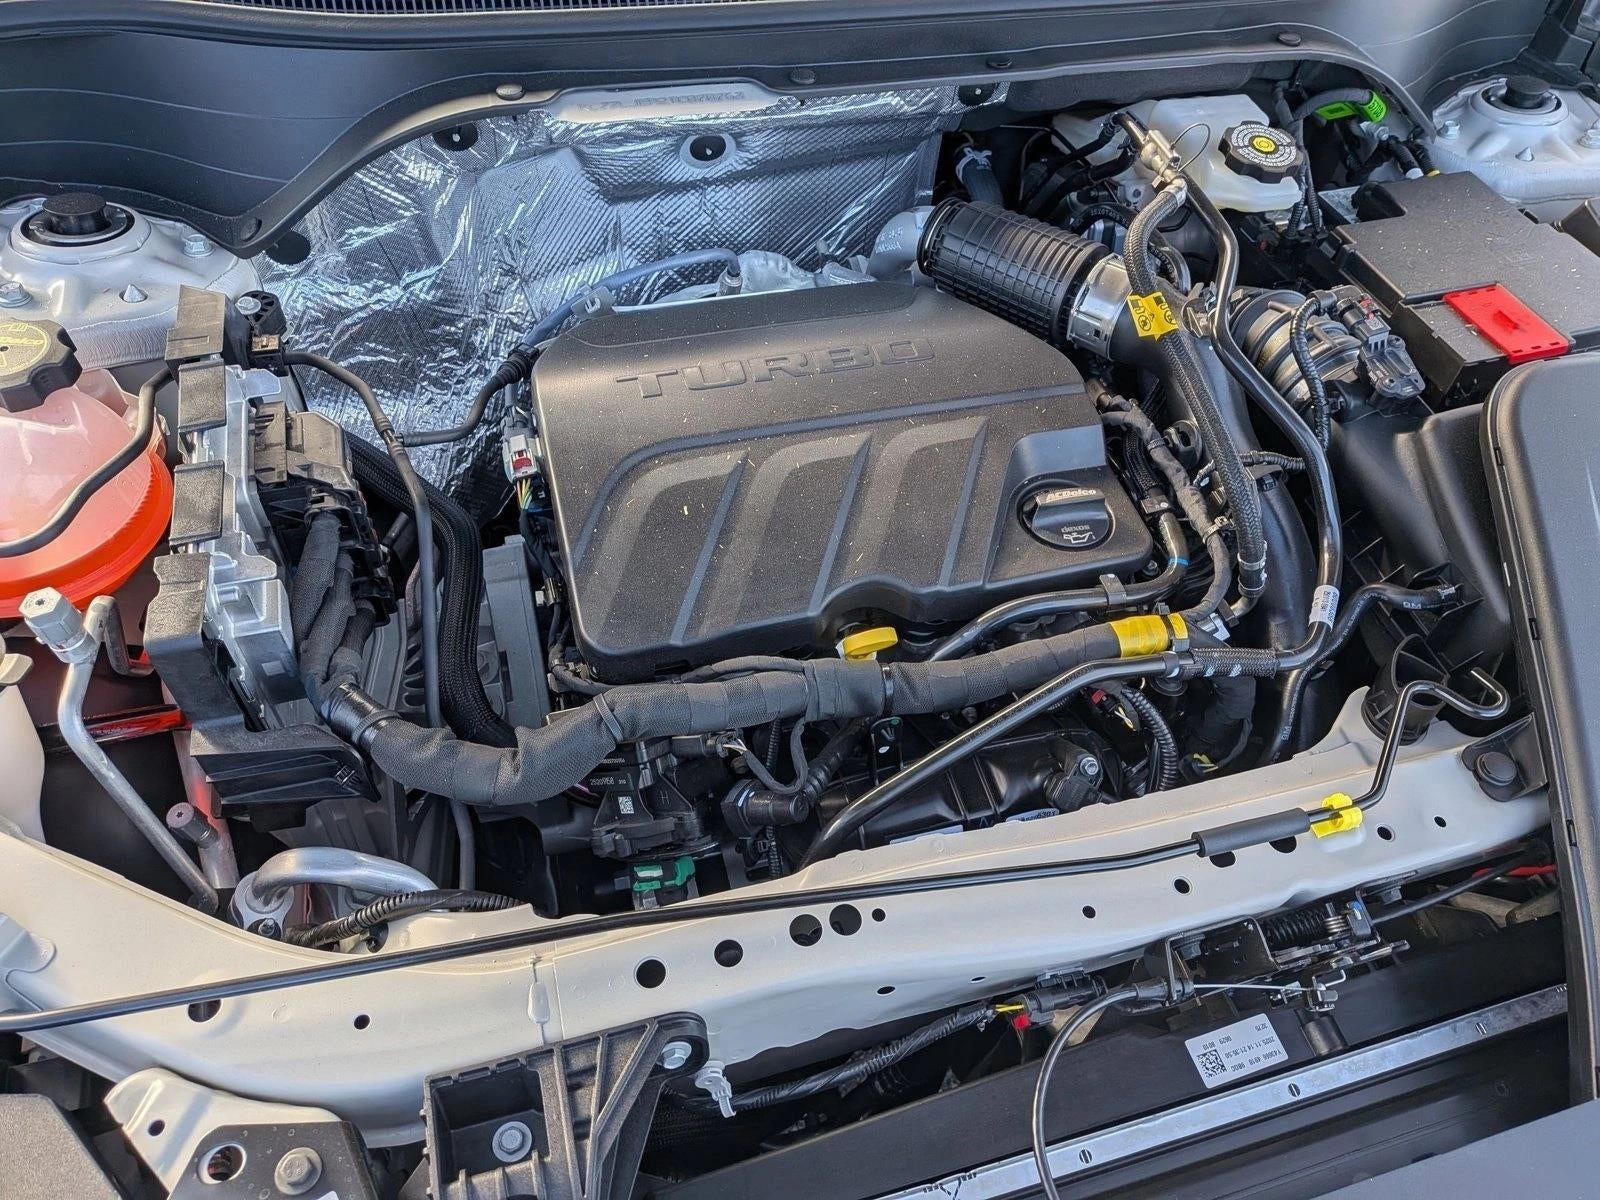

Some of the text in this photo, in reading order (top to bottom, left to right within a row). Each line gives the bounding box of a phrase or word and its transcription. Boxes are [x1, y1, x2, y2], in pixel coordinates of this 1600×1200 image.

[616, 339, 935, 399] TURBO
[1045, 489, 1097, 503] ACDelco
[1060, 524, 1091, 534] dexos
